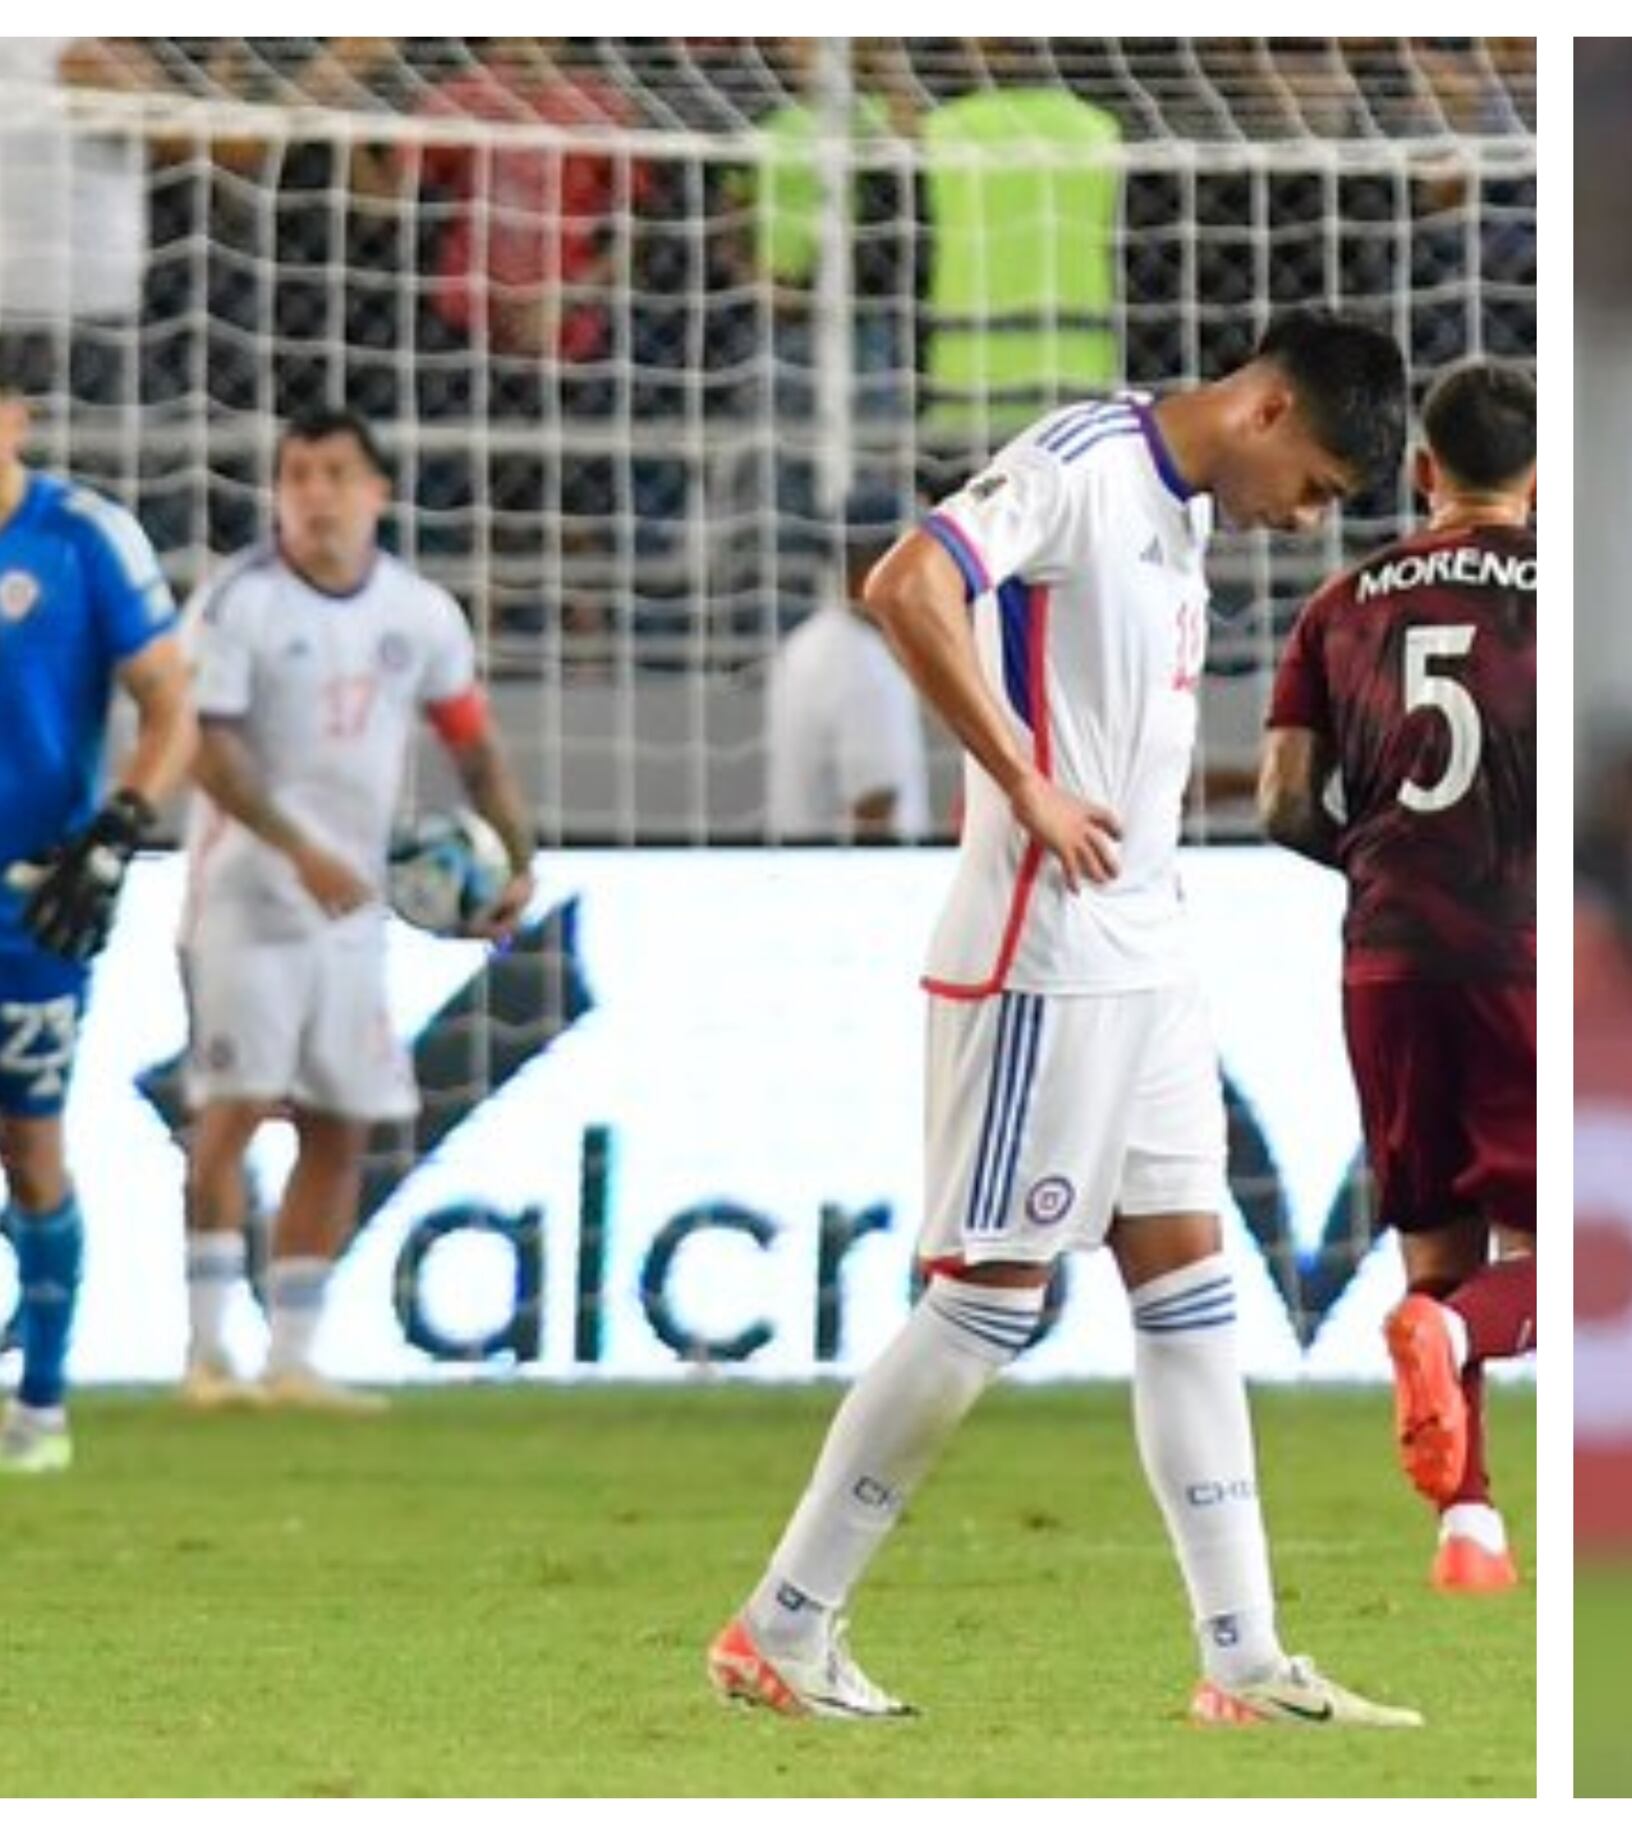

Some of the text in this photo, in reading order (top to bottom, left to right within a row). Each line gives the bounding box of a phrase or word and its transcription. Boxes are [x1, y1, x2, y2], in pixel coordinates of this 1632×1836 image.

[1355, 547, 1537, 604] MORENO
[1397, 625, 1482, 812] 5
[0, 994, 77, 1070] 23
